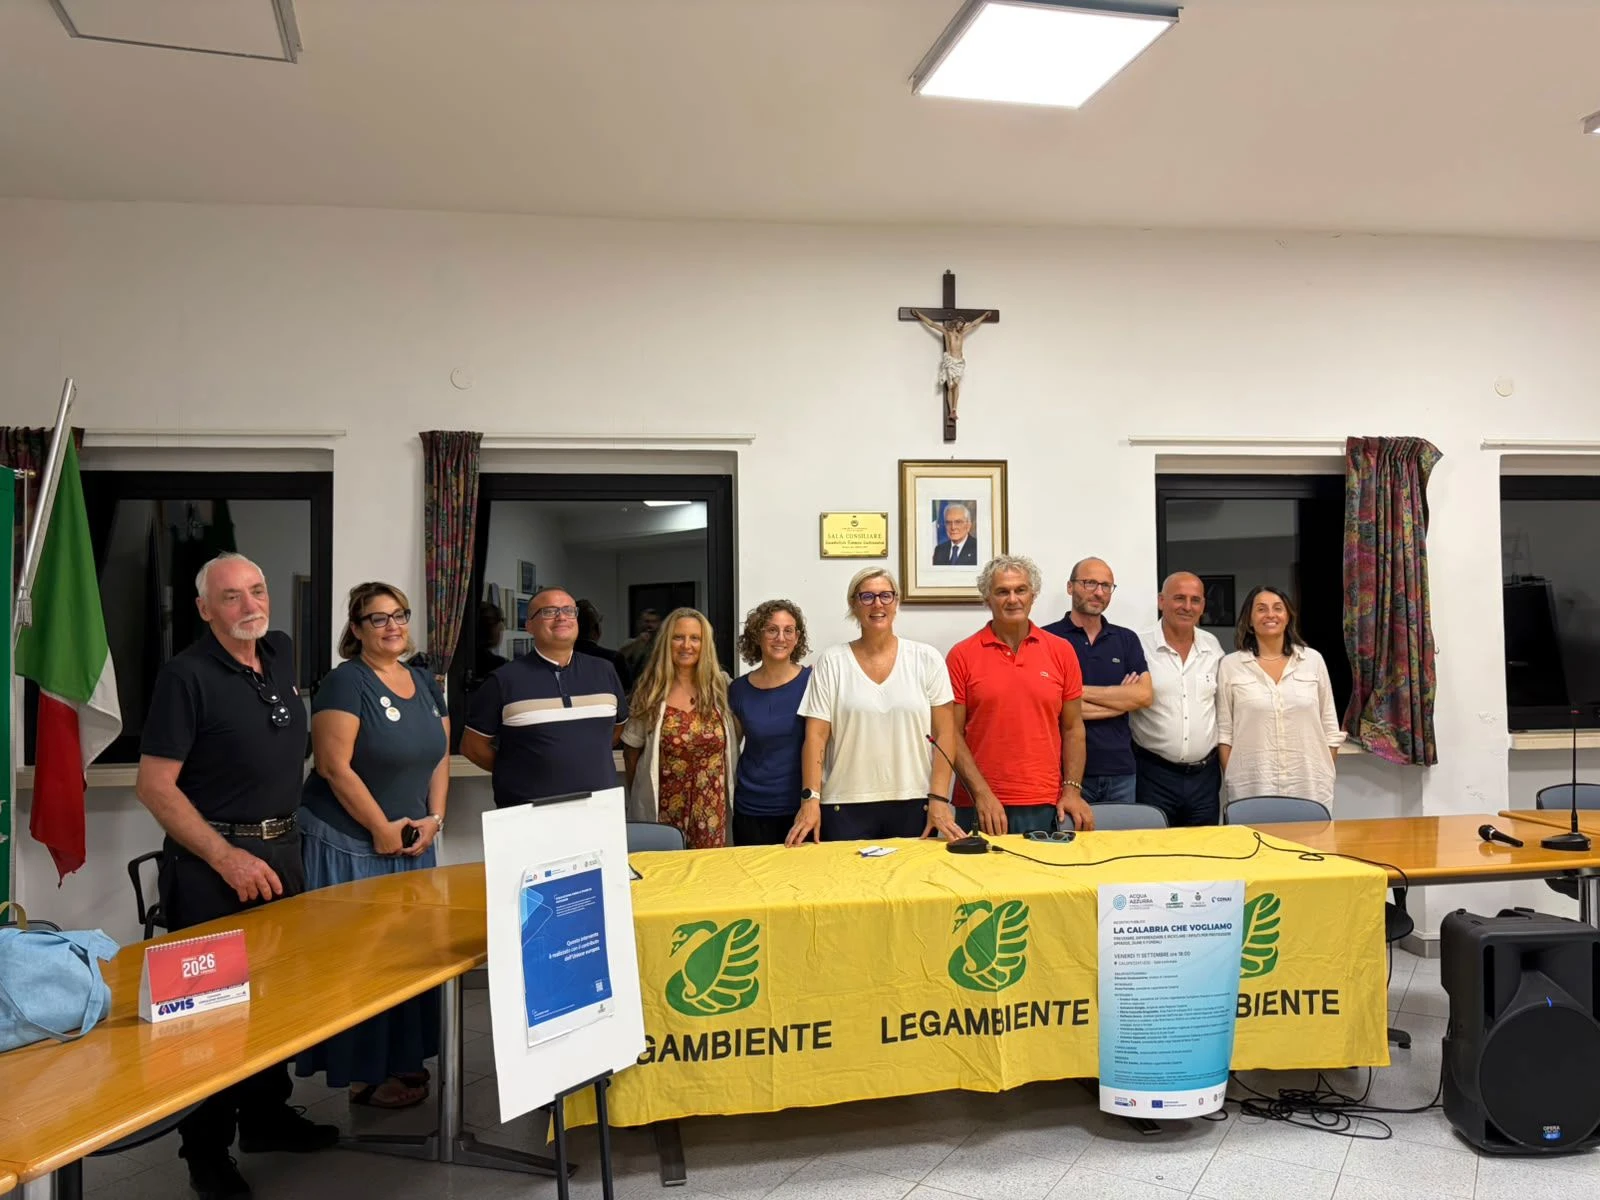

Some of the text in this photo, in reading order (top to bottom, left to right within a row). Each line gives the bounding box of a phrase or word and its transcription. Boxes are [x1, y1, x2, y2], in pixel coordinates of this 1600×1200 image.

[1126, 925, 1169, 934] CALABRIA
[1171, 924, 1188, 932] CHE
[1189, 922, 1232, 931] VOGLIAMO
[182, 953, 215, 978] 2026
[158, 998, 194, 1016] AVIS
[1236, 989, 1340, 1018] BIENTE
[881, 998, 1090, 1044] LEGAMBIENTE
[636, 1020, 832, 1065] GAMBIENTE
